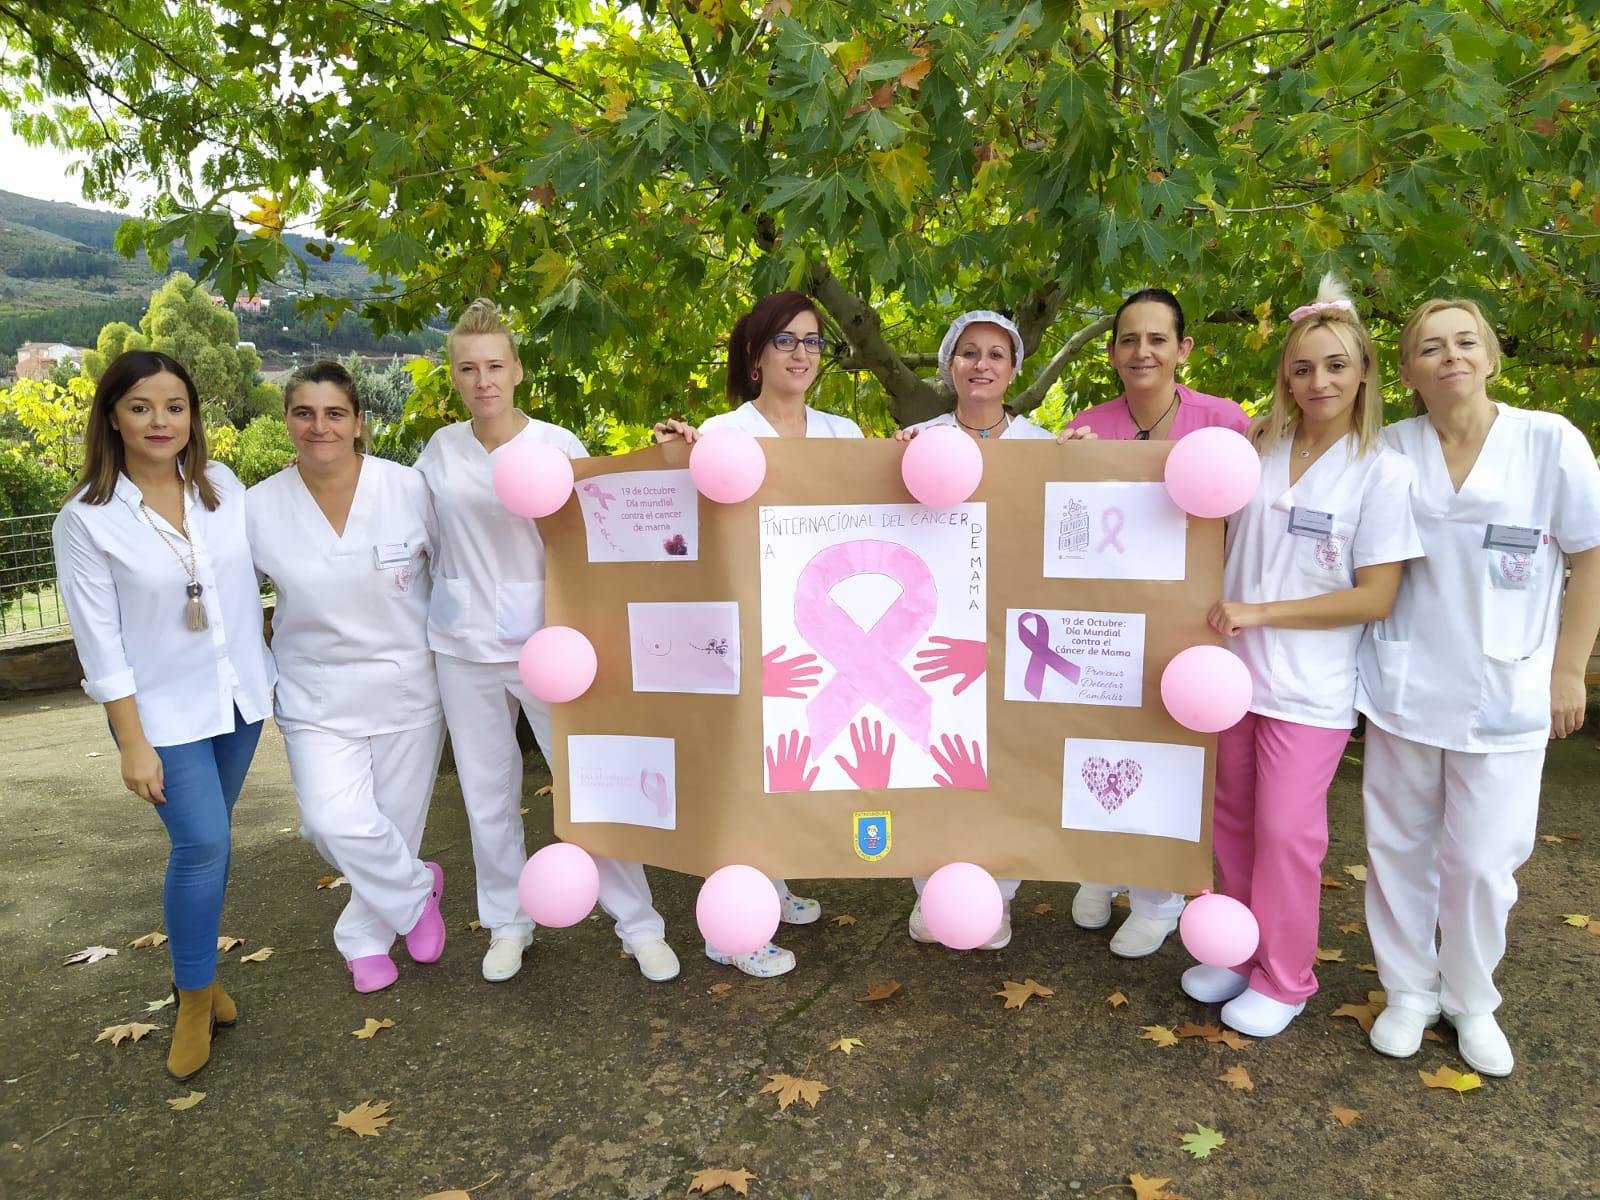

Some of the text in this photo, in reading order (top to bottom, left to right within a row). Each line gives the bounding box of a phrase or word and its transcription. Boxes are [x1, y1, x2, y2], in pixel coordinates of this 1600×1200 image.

[621, 486, 676, 495] 19 de Octubre
[645, 511, 653, 519] el
[882, 513, 904, 528] DEL
[633, 523, 643, 531] de
[1062, 617, 1126, 627] 19 de Octubre:
[1083, 628, 1121, 637] Mundial
[1071, 638, 1111, 647] contra el
[1088, 647, 1098, 655] de
[1101, 648, 1131, 657] Mama
